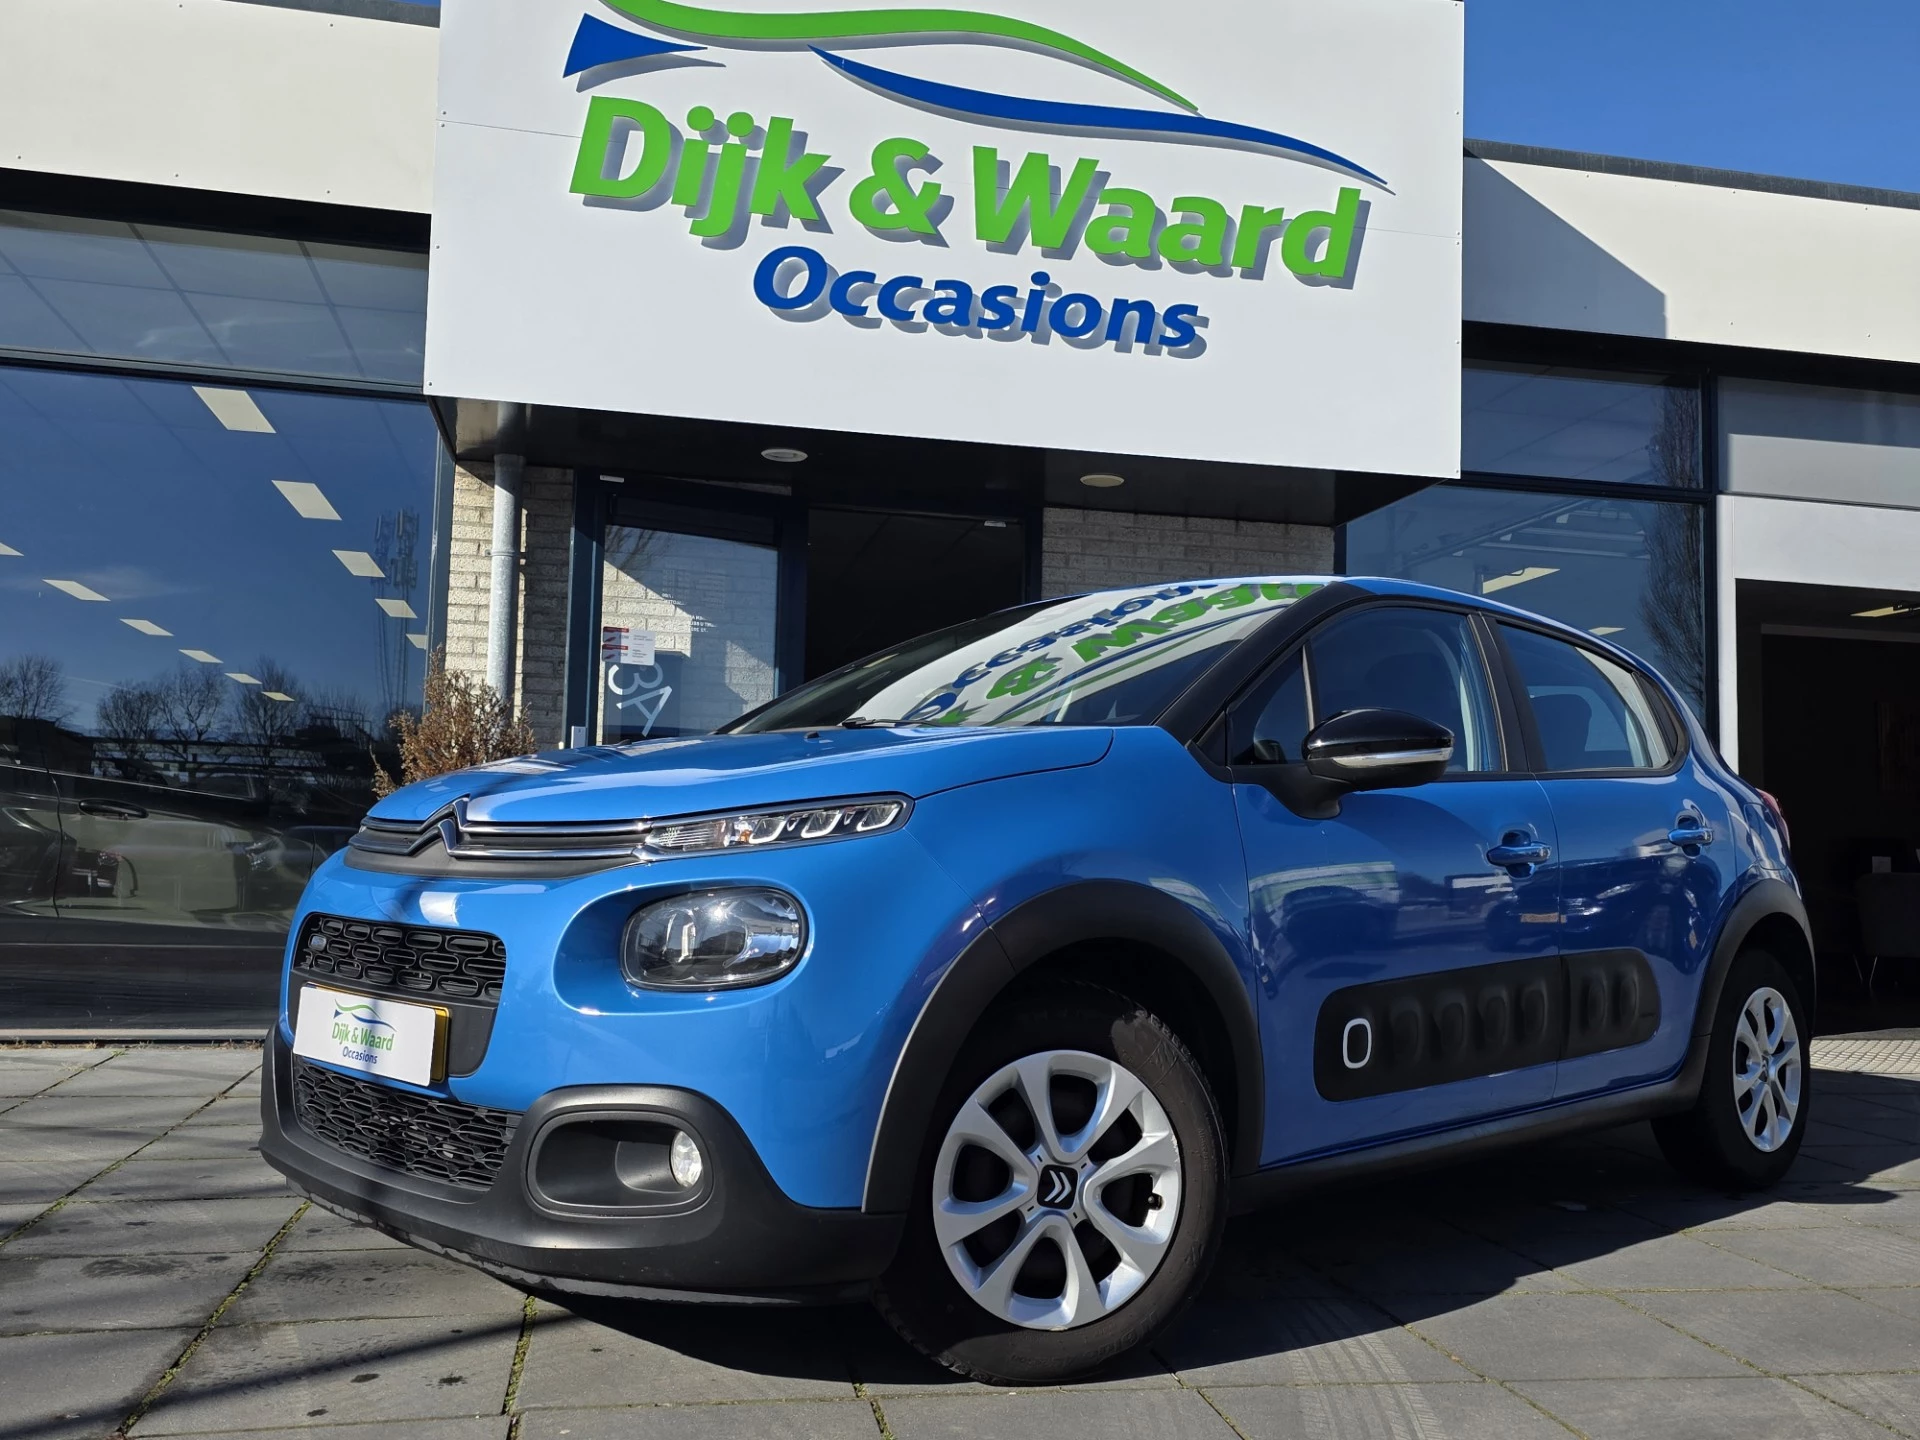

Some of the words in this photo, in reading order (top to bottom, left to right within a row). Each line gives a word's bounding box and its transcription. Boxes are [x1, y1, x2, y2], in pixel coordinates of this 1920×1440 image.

[569, 95, 831, 237] Dijk
[849, 137, 942, 234] &
[973, 145, 1361, 278] Waard
[753, 246, 1199, 348] Occasions
[332, 1022, 350, 1044] Dijk
[351, 1027, 359, 1044] &
[361, 1028, 394, 1051] Waard
[342, 1046, 378, 1064] Occasions
